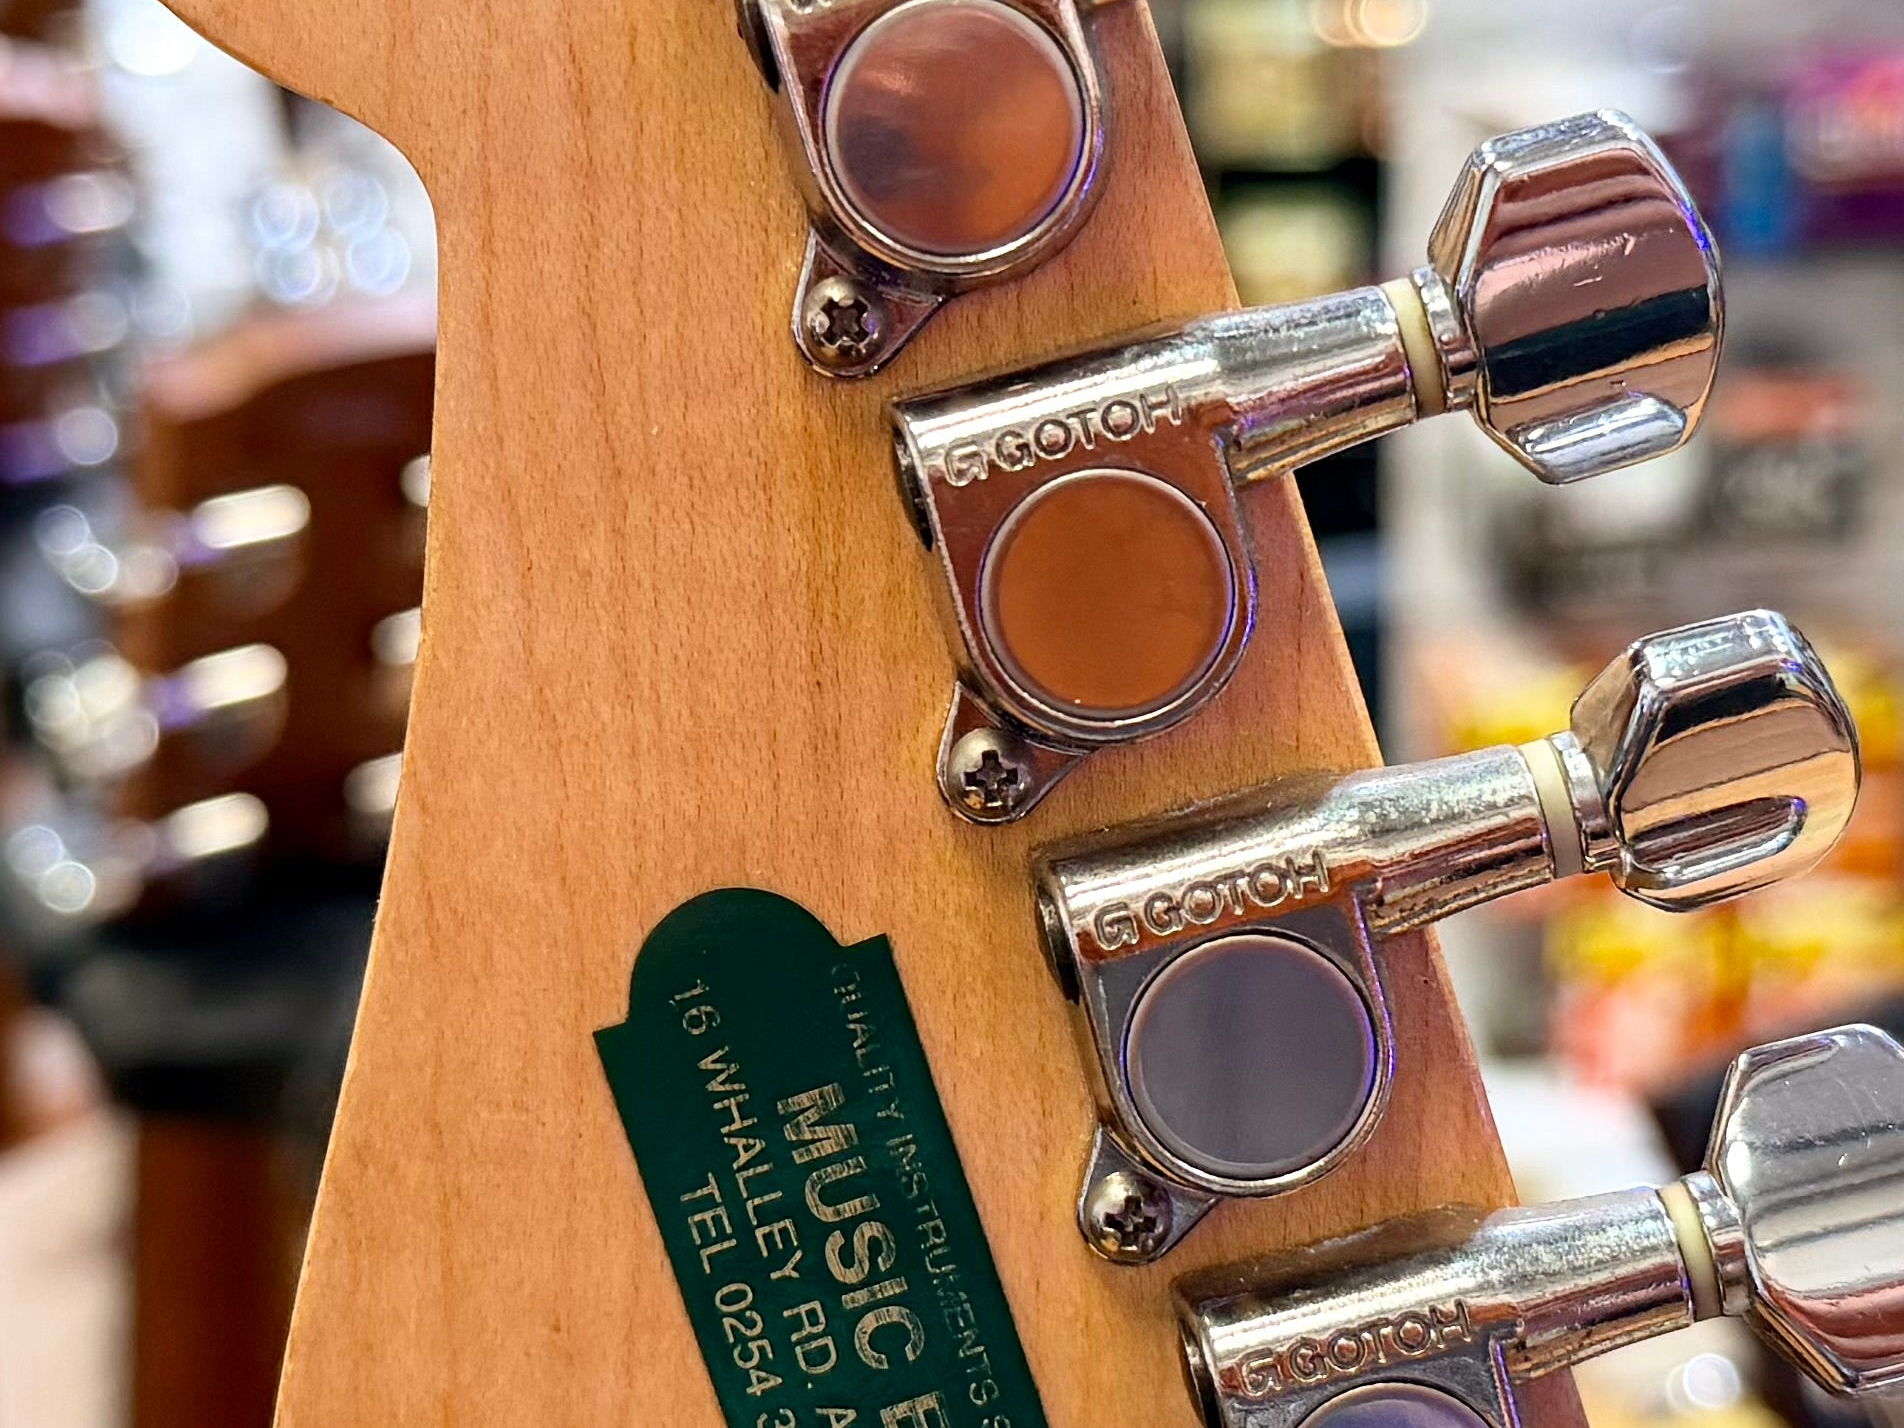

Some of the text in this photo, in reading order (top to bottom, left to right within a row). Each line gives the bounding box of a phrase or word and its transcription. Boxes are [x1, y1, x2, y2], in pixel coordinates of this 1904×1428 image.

[996, 386, 1183, 472] GOTOH
[1143, 849, 1329, 936] GOTOH
[672, 978, 722, 1034] 16
[696, 1045, 800, 1283] WHALLEY
[777, 1082, 926, 1370] MUSIC
[680, 1173, 734, 1275] TEL
[713, 1282, 782, 1398] 0254
[783, 1298, 840, 1390] RD.
[1287, 1299, 1472, 1383] GOTOH
